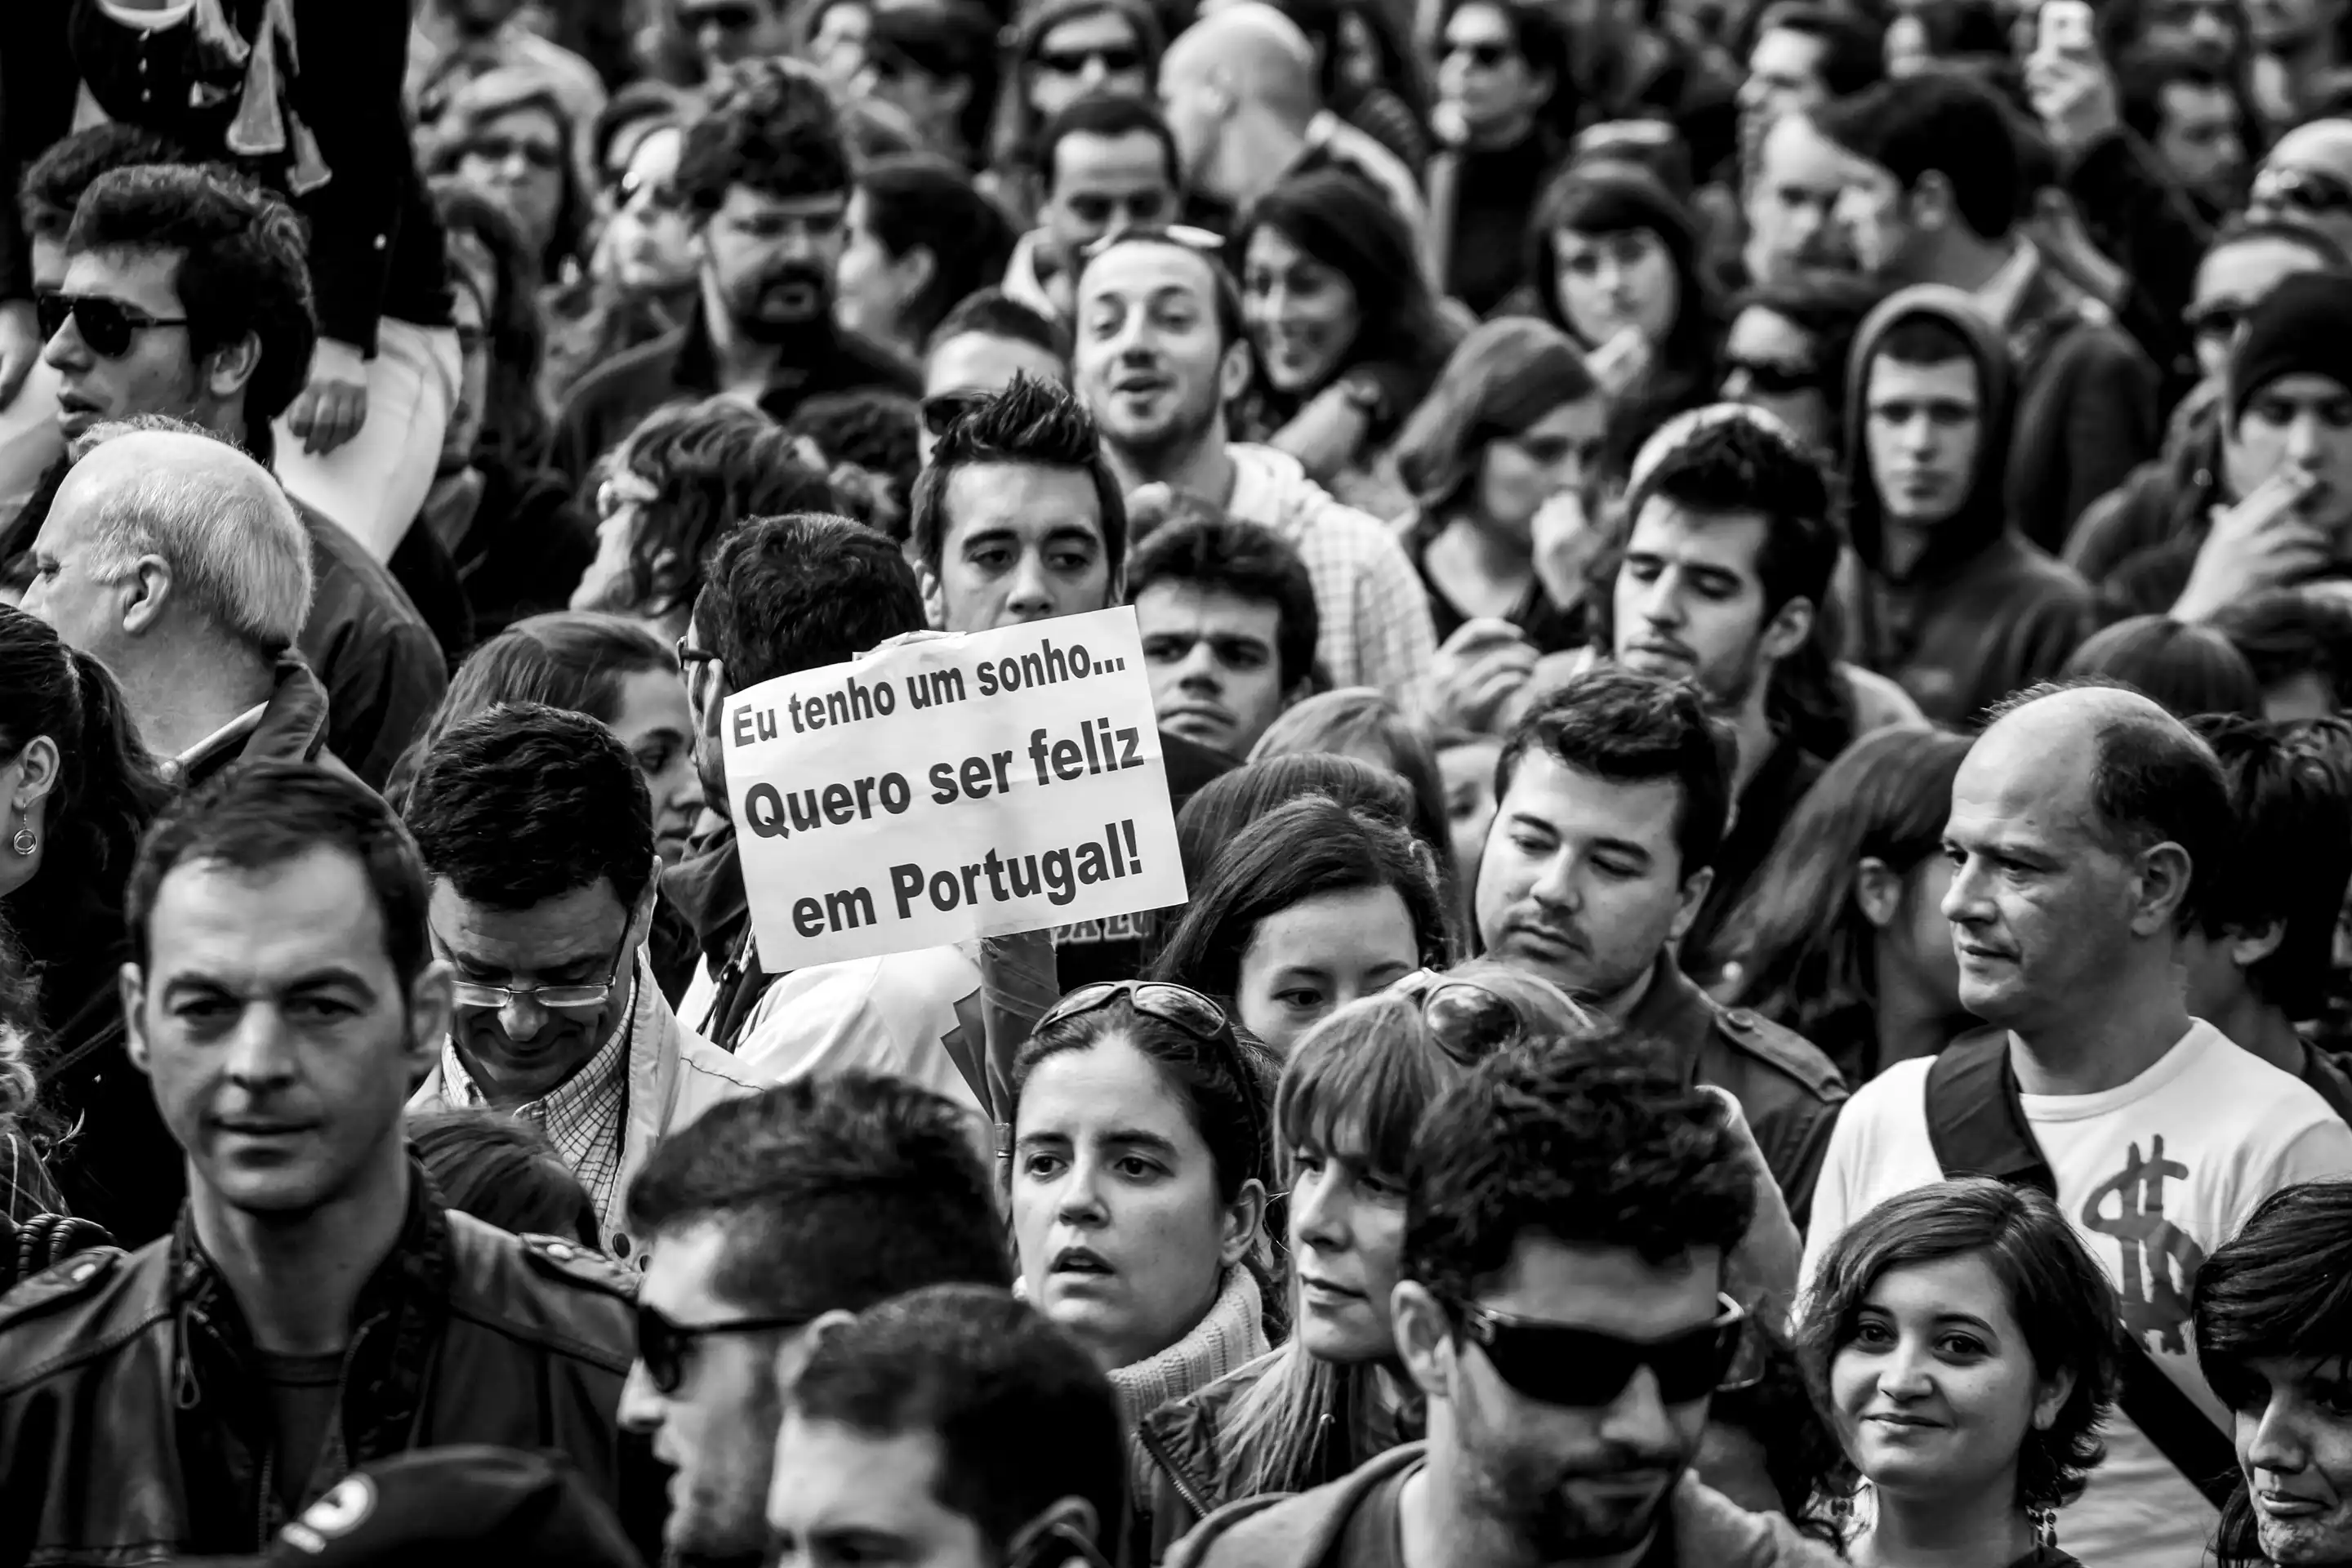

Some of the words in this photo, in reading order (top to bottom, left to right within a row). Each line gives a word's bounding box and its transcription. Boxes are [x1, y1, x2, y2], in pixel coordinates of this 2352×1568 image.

[733, 703, 777, 747] Eu
[789, 676, 897, 733] tenho
[906, 667, 967, 710] um
[977, 638, 1125, 697] sonho...
[745, 772, 911, 840] Quero
[929, 750, 1013, 805] ser
[1027, 717, 1145, 786] feliz
[792, 886, 877, 938] em
[889, 818, 1143, 920] Portugal!
